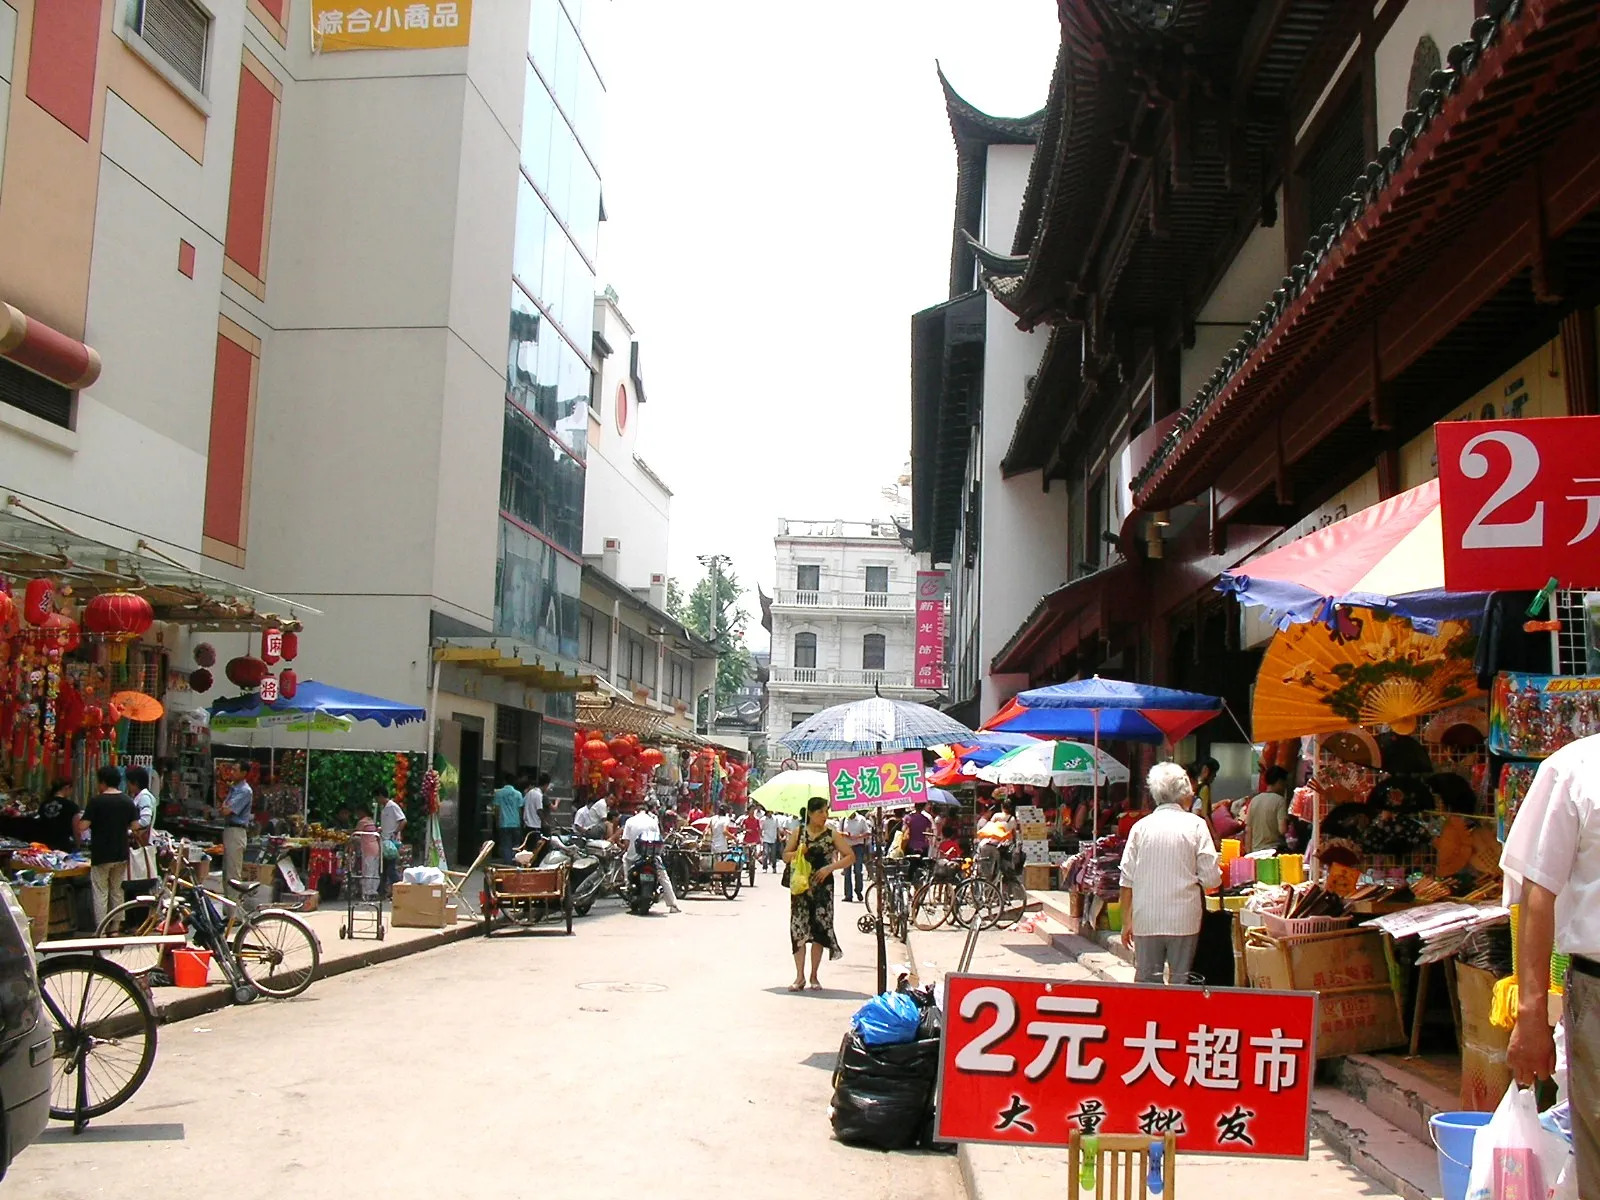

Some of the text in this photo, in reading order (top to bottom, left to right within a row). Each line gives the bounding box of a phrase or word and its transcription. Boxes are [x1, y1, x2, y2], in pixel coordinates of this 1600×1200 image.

[317, 2, 459, 35] 綜合小商品
[918, 601, 934, 676] 新光饰品
[832, 762, 924, 802] 全场2元
[955, 986, 1304, 1093] 2元大超市
[994, 1095, 1255, 1146] 大量批发
